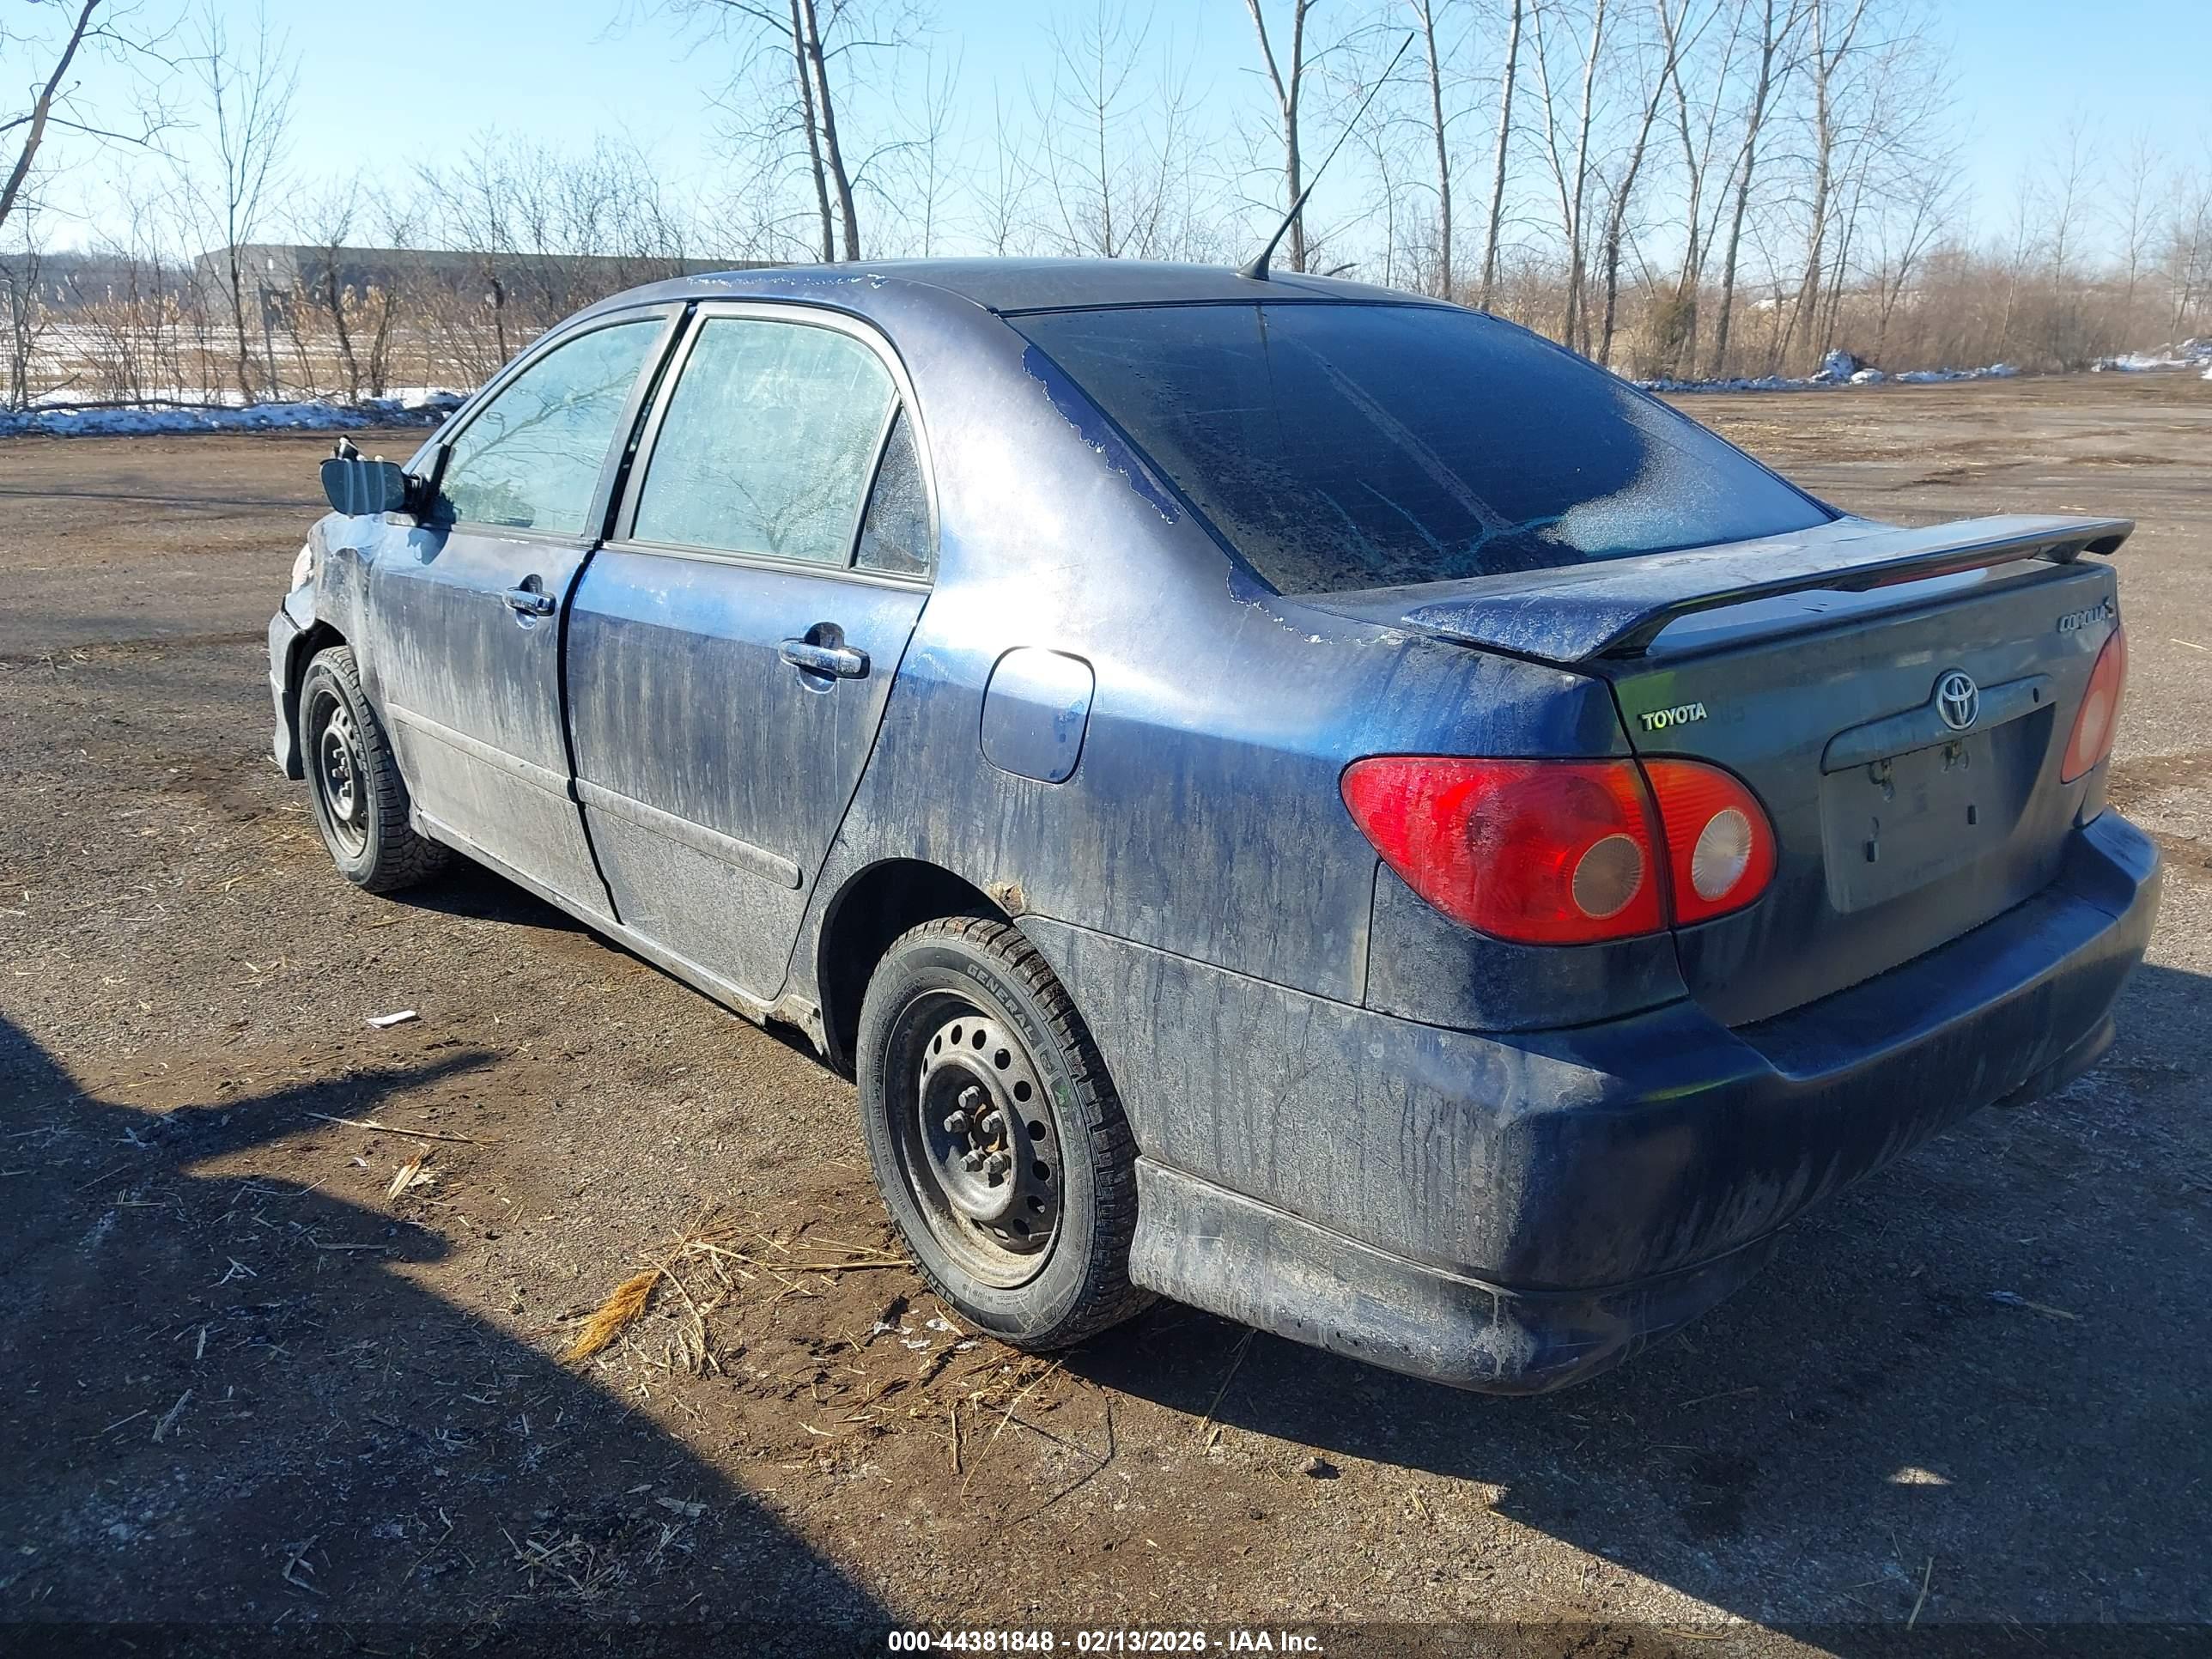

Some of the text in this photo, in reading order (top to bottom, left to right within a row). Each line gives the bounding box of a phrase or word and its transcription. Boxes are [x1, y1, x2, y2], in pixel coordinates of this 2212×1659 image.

[2057, 605, 2106, 632] COROLLA
[1639, 702, 1708, 731] TOYOTA
[966, 963, 1034, 1041] GENERAL
[898, 1225, 956, 1305] GENERAL
